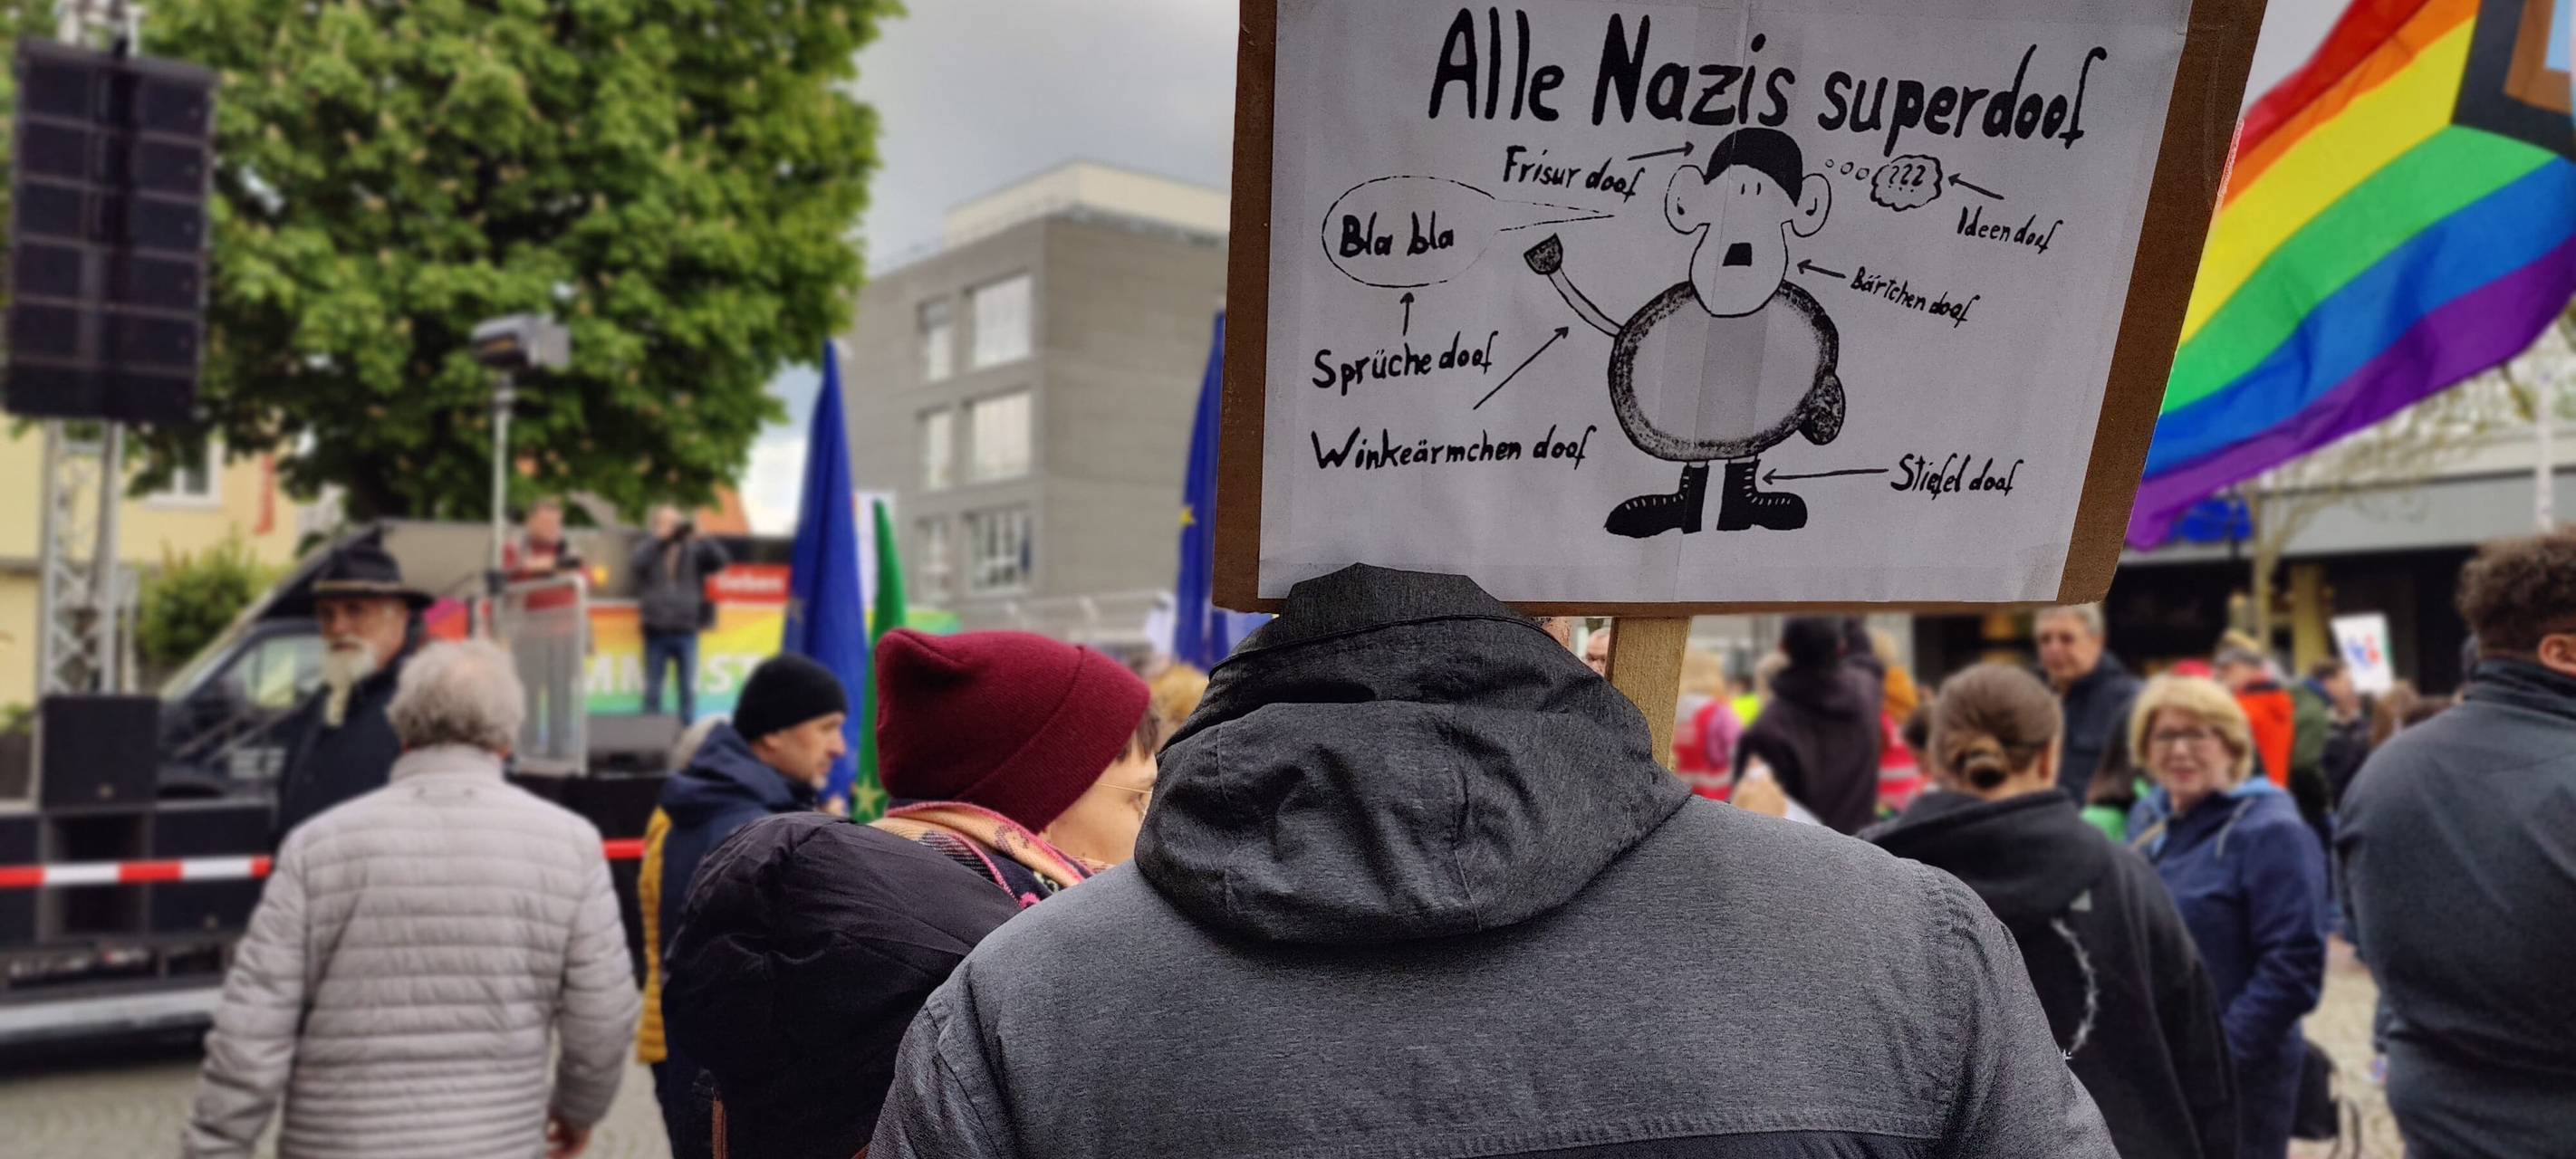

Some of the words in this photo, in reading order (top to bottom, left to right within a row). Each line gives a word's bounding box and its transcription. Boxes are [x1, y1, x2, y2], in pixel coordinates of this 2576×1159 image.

[1428, 6, 1565, 122] Alle
[1591, 13, 1795, 128] Nazis
[1817, 43, 2108, 158] superdoof
[1504, 144, 1582, 189] Frisur
[1585, 157, 1646, 203] doof
[1888, 163, 1927, 194] ???
[1339, 211, 1394, 258] Bla
[1407, 210, 1455, 256] bla
[1956, 205, 2011, 243] Ideen
[1850, 265, 1927, 311] Bärtchen
[1927, 291, 1981, 329] doof
[1312, 342, 1432, 397] Sprüche
[1438, 330, 1499, 375] doof
[1311, 426, 1523, 470] Winkeärmchen
[1533, 424, 1598, 471] doof
[1890, 452, 1972, 500] Stiefel
[1968, 457, 2024, 496] doof
